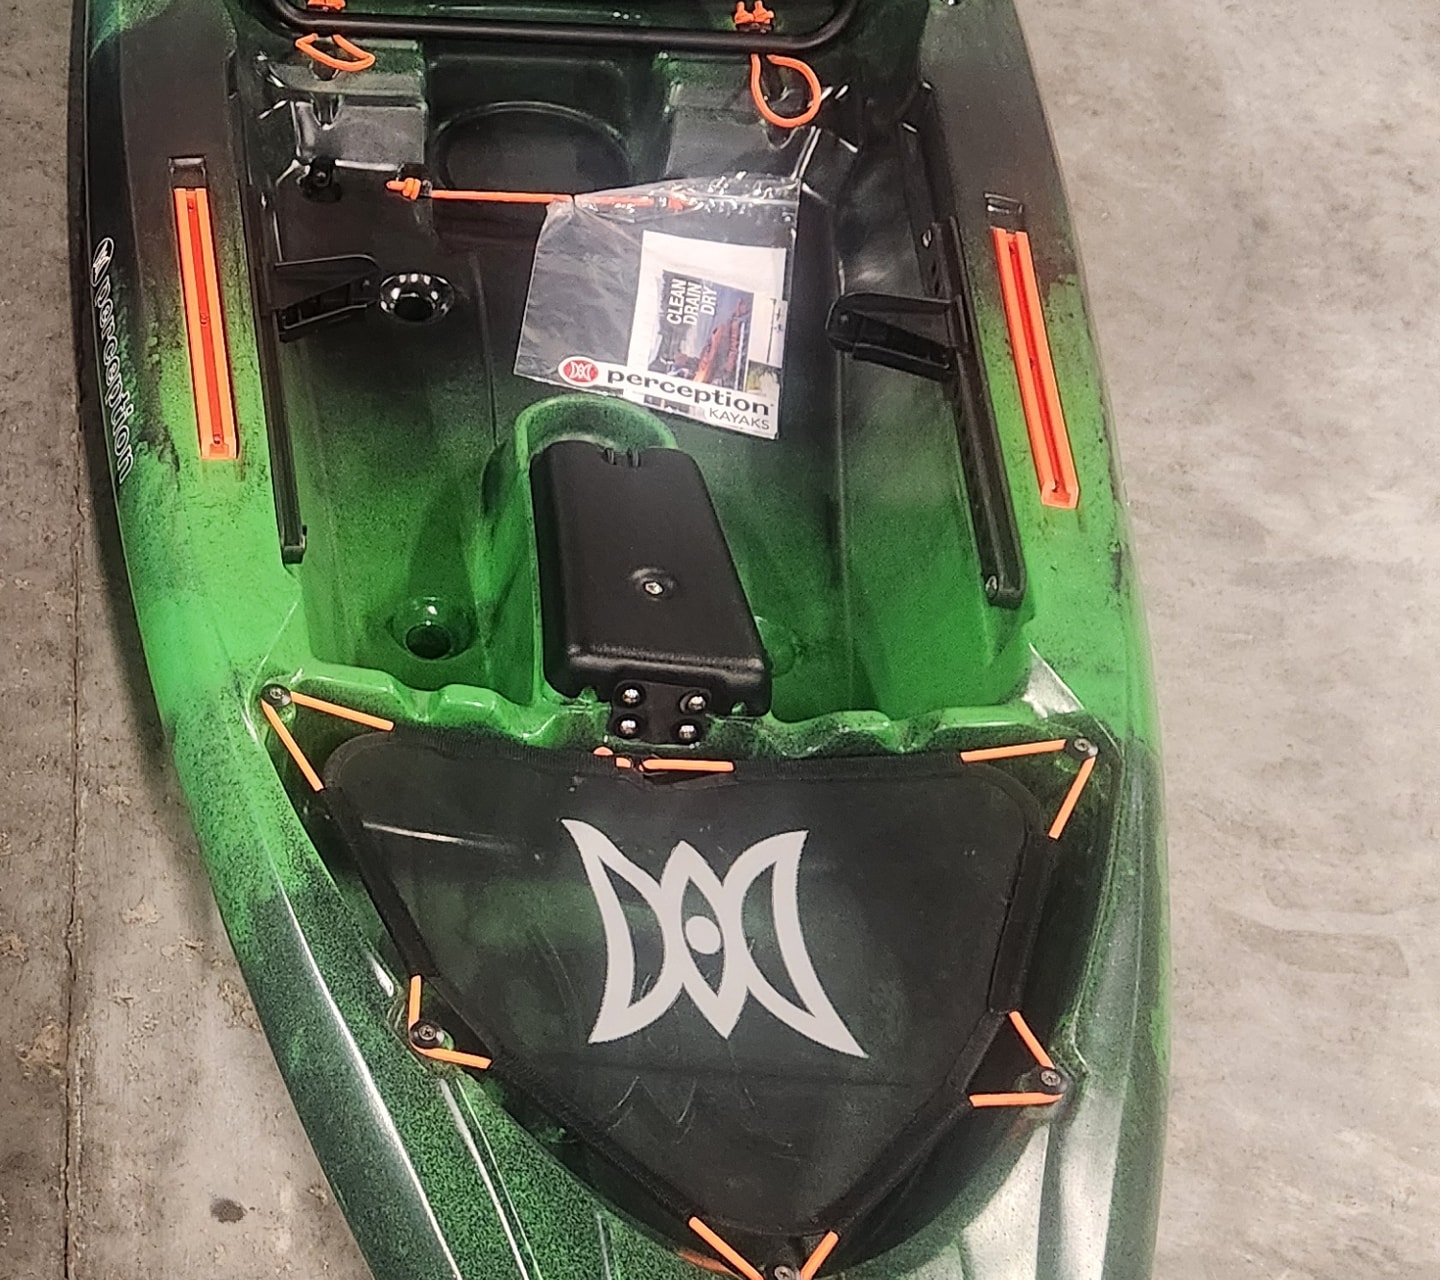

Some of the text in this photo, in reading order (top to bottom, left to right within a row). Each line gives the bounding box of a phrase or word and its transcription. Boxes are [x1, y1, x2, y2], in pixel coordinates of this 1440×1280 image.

[666, 278, 688, 325] CLEAN
[683, 281, 702, 326] DRAIN
[700, 284, 718, 316] DRY
[95, 277, 133, 483] perception
[607, 369, 770, 416] perception
[708, 407, 771, 431] KAYAKS
